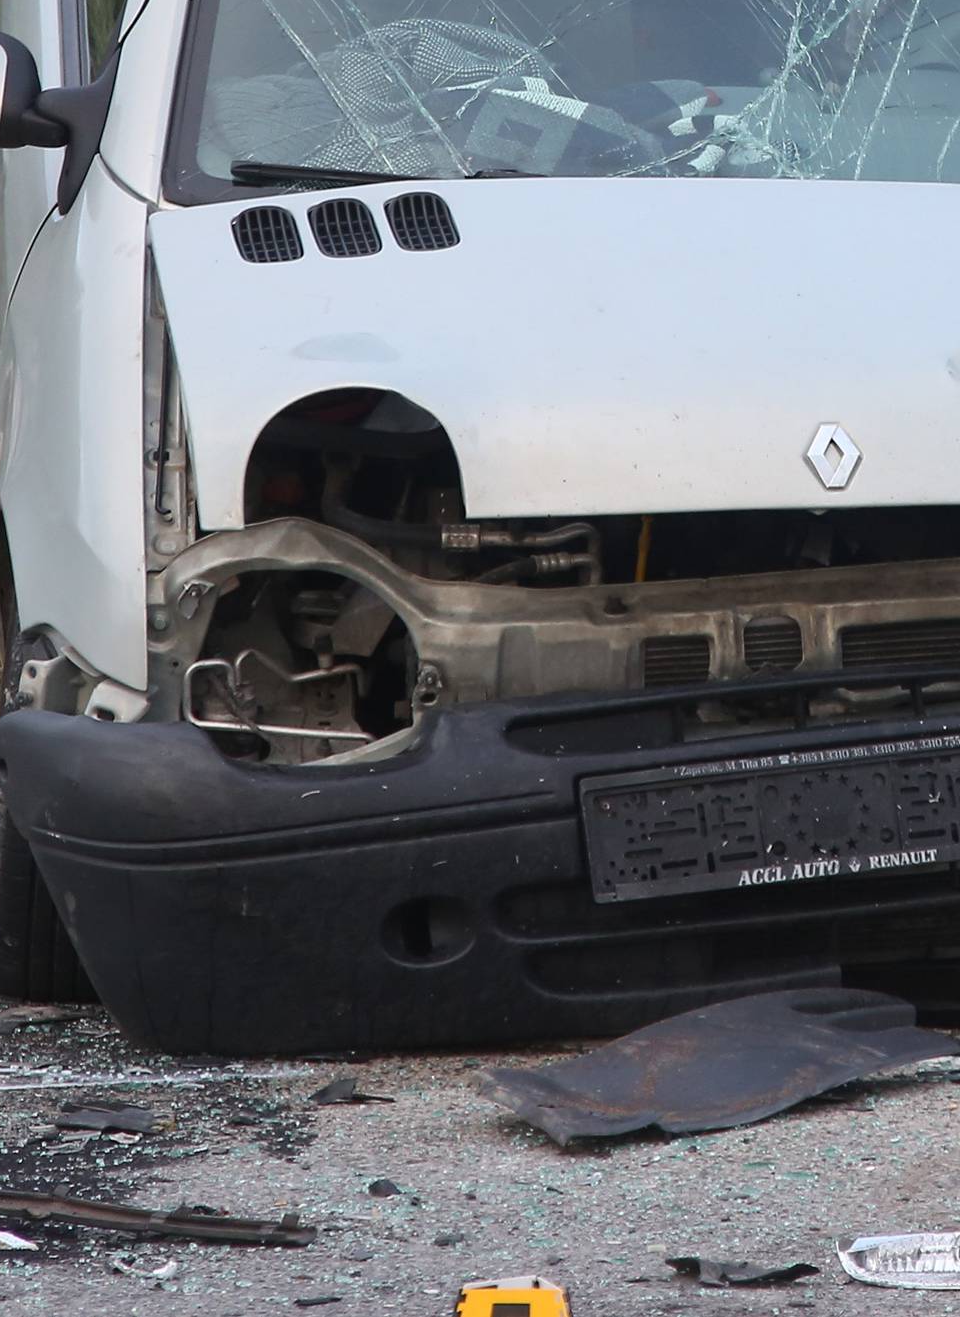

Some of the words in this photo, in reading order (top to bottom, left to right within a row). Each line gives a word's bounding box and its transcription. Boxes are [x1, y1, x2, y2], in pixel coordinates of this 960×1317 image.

[740, 758, 758, 770] Tita
[760, 756, 773, 767] 85
[872, 744, 895, 756] 3310
[920, 738, 942, 749] 3310
[792, 860, 840, 880] AUTO
[869, 849, 938, 869] RENAULT
